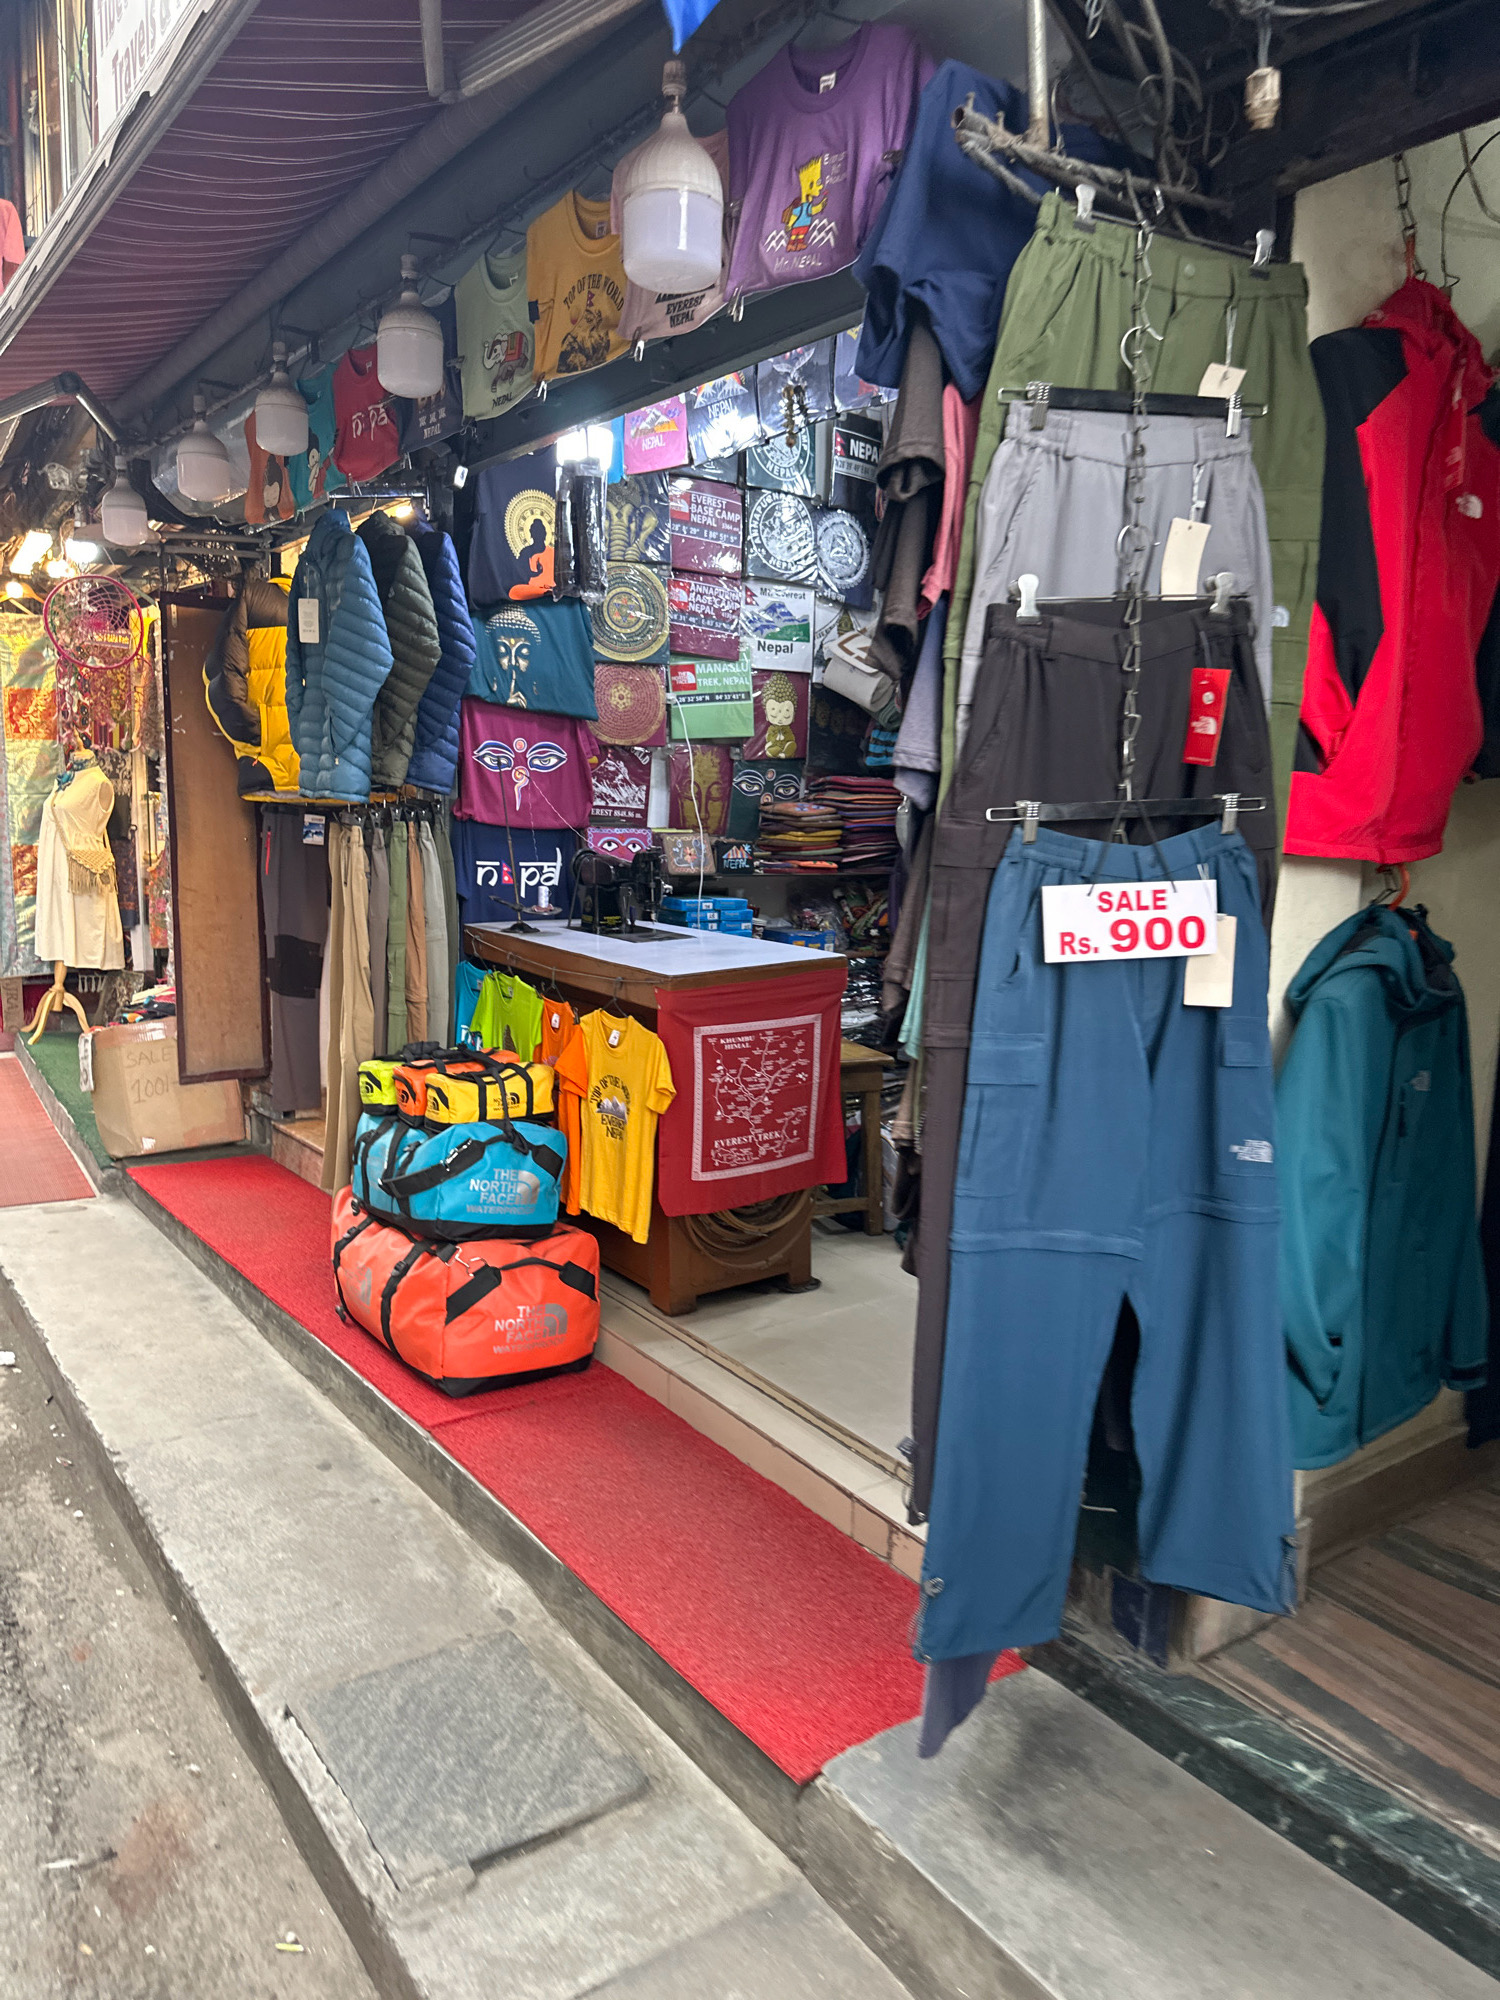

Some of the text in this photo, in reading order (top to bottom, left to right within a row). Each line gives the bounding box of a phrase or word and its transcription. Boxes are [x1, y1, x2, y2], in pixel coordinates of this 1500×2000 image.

[112, 0, 156, 116] Travels
[563, 274, 624, 311] TOP OF THE WORLD
[665, 293, 706, 315] EVEREST
[670, 309, 695, 328] NEPAL
[492, 392, 513, 410] NEPAL
[707, 399, 737, 418] NEPAL
[424, 424, 441, 439] NEPAL
[642, 434, 666, 451] NEPAL
[766, 460, 797, 479] NEPAL
[691, 493, 727, 509] EVEREST
[690, 503, 741, 523] BASE CAMP
[690, 513, 717, 527] NEPAL
[690, 582, 741, 602] ANNAPURNA
[689, 591, 714, 605] BASE
[715, 598, 741, 610] CAMP
[688, 602, 716, 616] NEPAL
[757, 640, 794, 656] Nepal
[696, 660, 749, 673] MANASLU
[697, 676, 750, 687] TREK, NEPAL
[723, 857, 750, 870] NEPAL
[1097, 889, 1167, 913] SALE
[1059, 915, 1206, 955] Rs. 900
[720, 1034, 756, 1045] KHUMBU
[724, 1042, 751, 1051] HIMAL
[125, 1046, 174, 1069] SALE
[714, 1130, 783, 1149] EVEREST TREK
[493, 1167, 518, 1181] THE
[469, 1178, 516, 1193] NORTH
[480, 1192, 516, 1205] FACE
[466, 1203, 536, 1216] WATERPROOF
[516, 1305, 544, 1318] THE
[494, 1318, 544, 1332] NORTH
[506, 1328, 541, 1344] FACE
[492, 1336, 566, 1354] WATERPROOF
